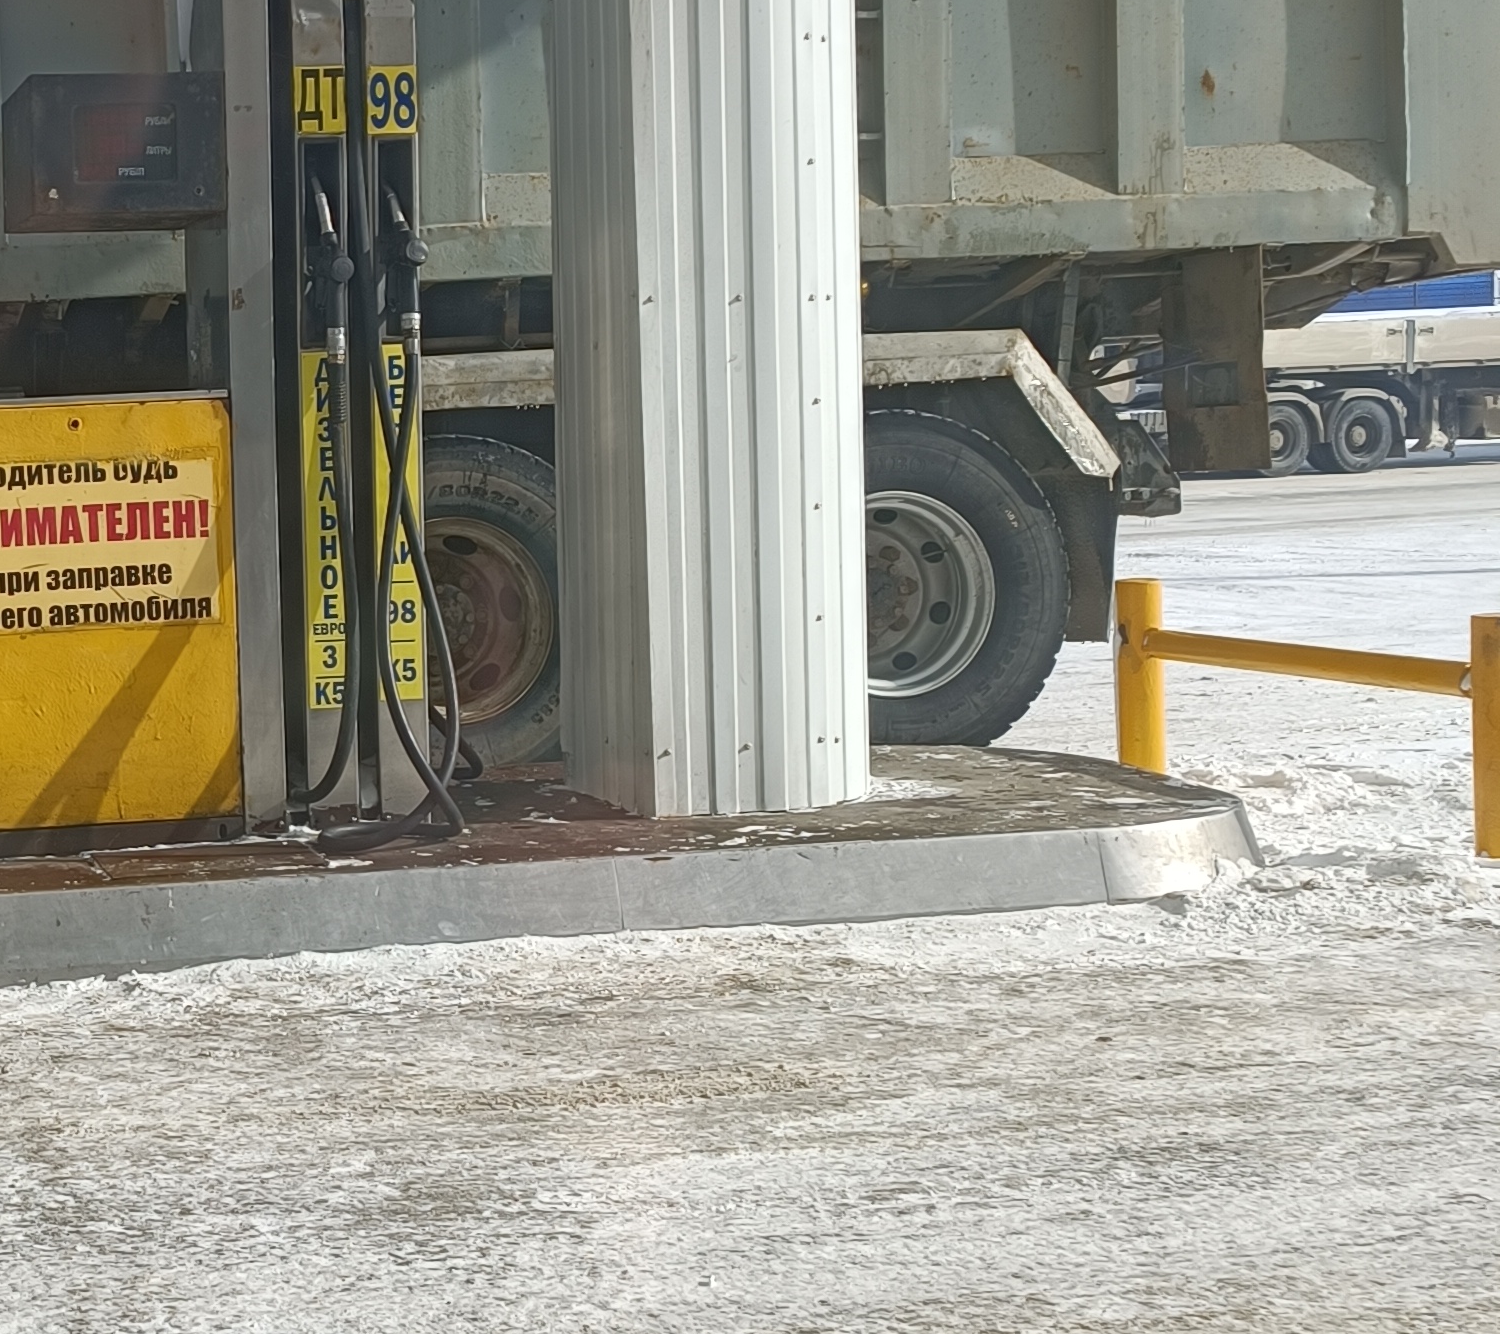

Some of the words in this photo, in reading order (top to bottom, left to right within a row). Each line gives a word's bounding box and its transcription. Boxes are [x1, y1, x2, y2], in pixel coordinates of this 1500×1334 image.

[297, 69, 344, 132] ДТ
[369, 72, 416, 129] 98
[46, 563, 173, 591] заправке
[49, 595, 212, 627] автомобиля
[313, 622, 345, 636] ЕВРО
[322, 645, 338, 669] 3
